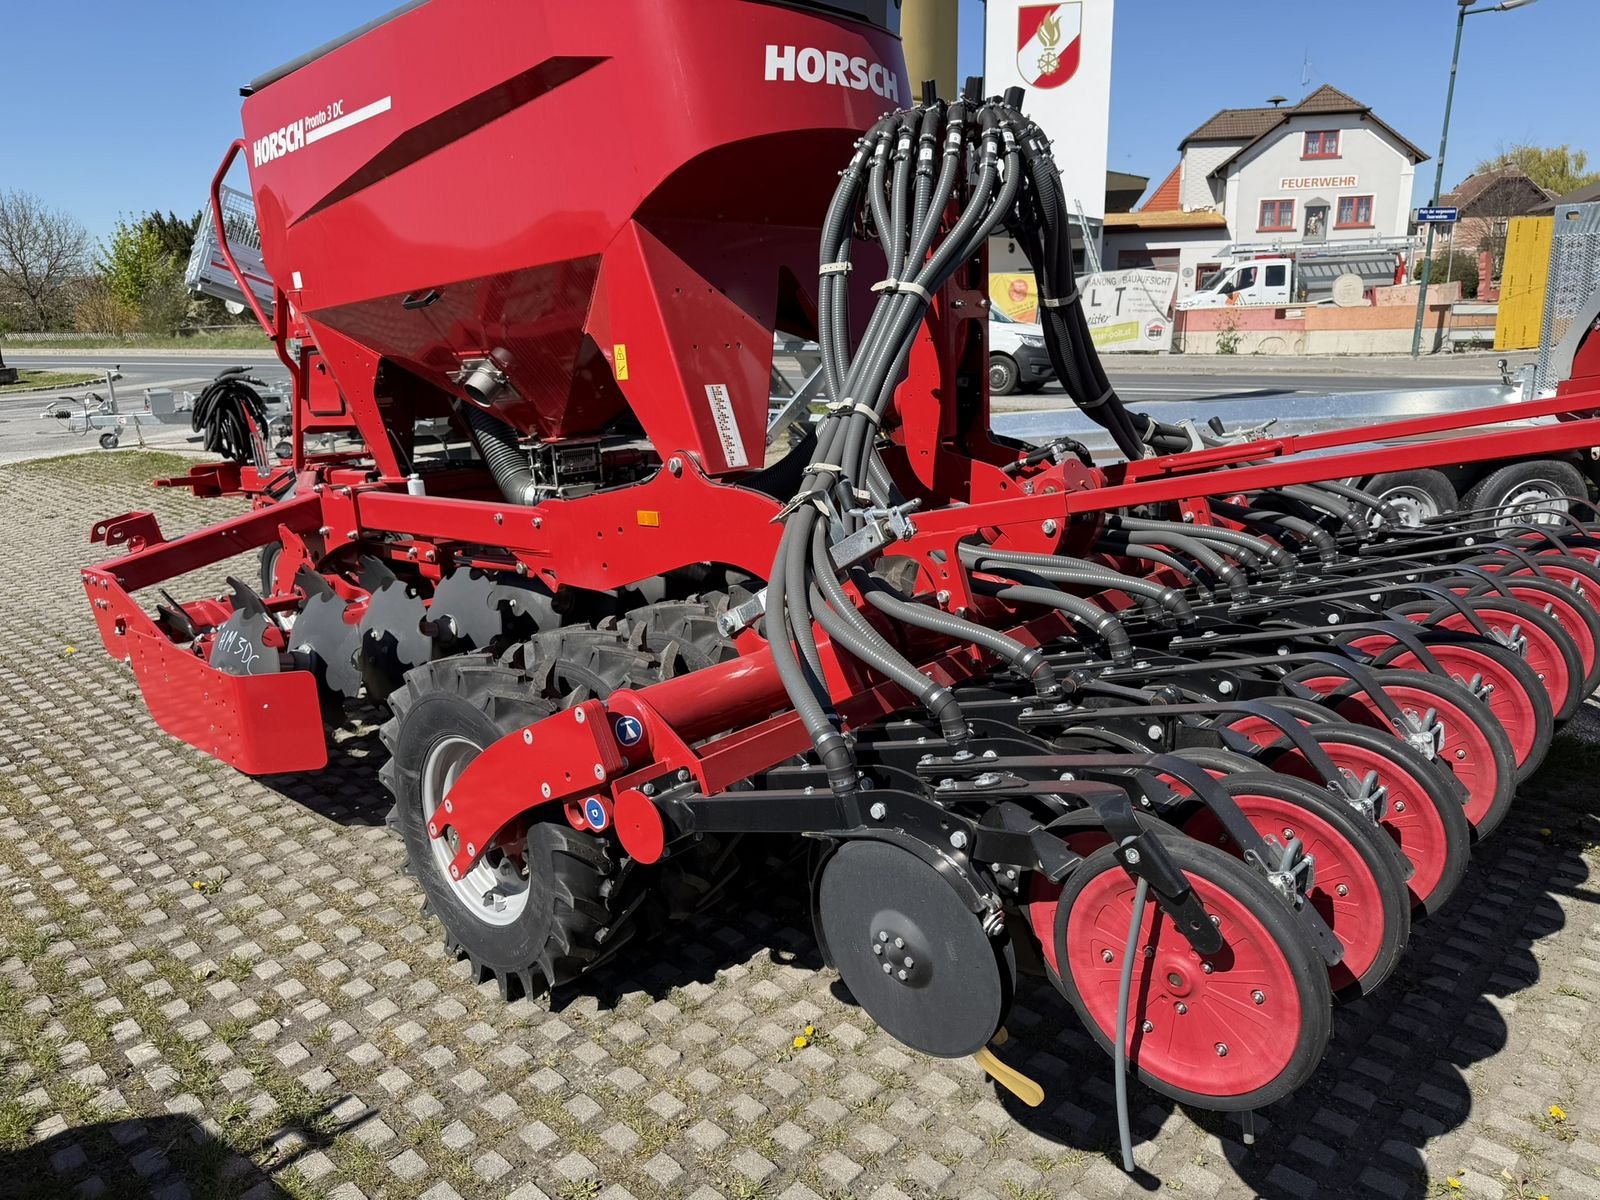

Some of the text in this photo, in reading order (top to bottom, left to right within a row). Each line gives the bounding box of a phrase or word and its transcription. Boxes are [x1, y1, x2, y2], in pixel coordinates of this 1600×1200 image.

[764, 45, 899, 103] HORSCH
[305, 99, 344, 131] Pronto 3 DC
[253, 119, 305, 168] HORSCH
[1281, 176, 1356, 188] FEUERWEHR
[1122, 275, 1172, 287] BAUAUFSICHT
[1087, 312, 1111, 325] eister
